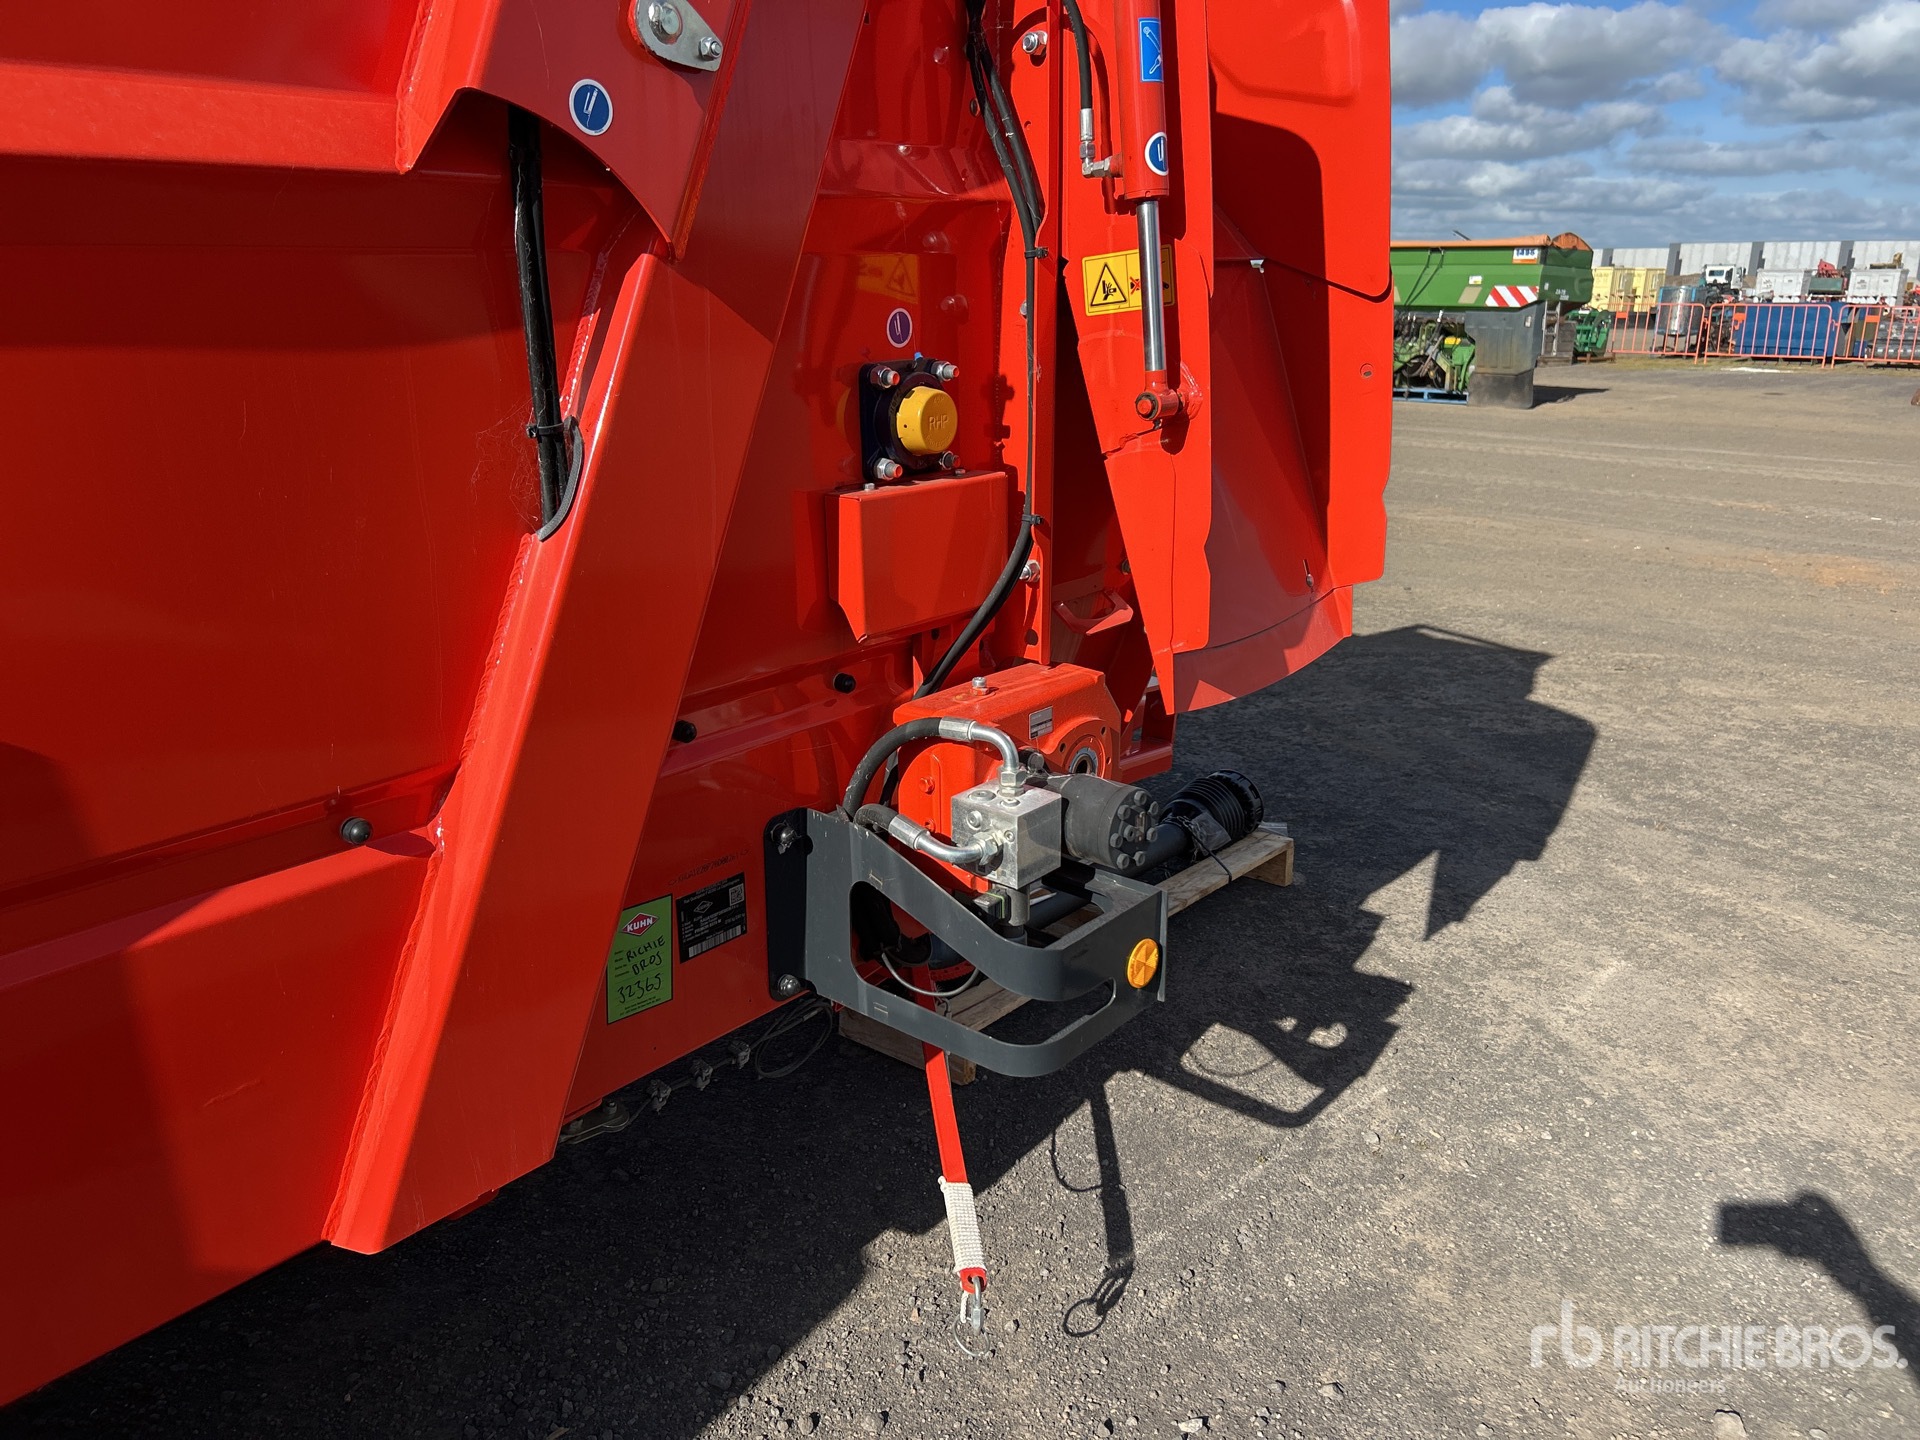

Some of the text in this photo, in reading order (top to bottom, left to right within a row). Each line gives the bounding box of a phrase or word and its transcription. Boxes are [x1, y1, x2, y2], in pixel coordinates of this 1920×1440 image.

[929, 414, 949, 431] RHP
[626, 917, 654, 933] KUHN
[626, 935, 666, 962] RICHIE
[617, 972, 662, 1004] 32365
